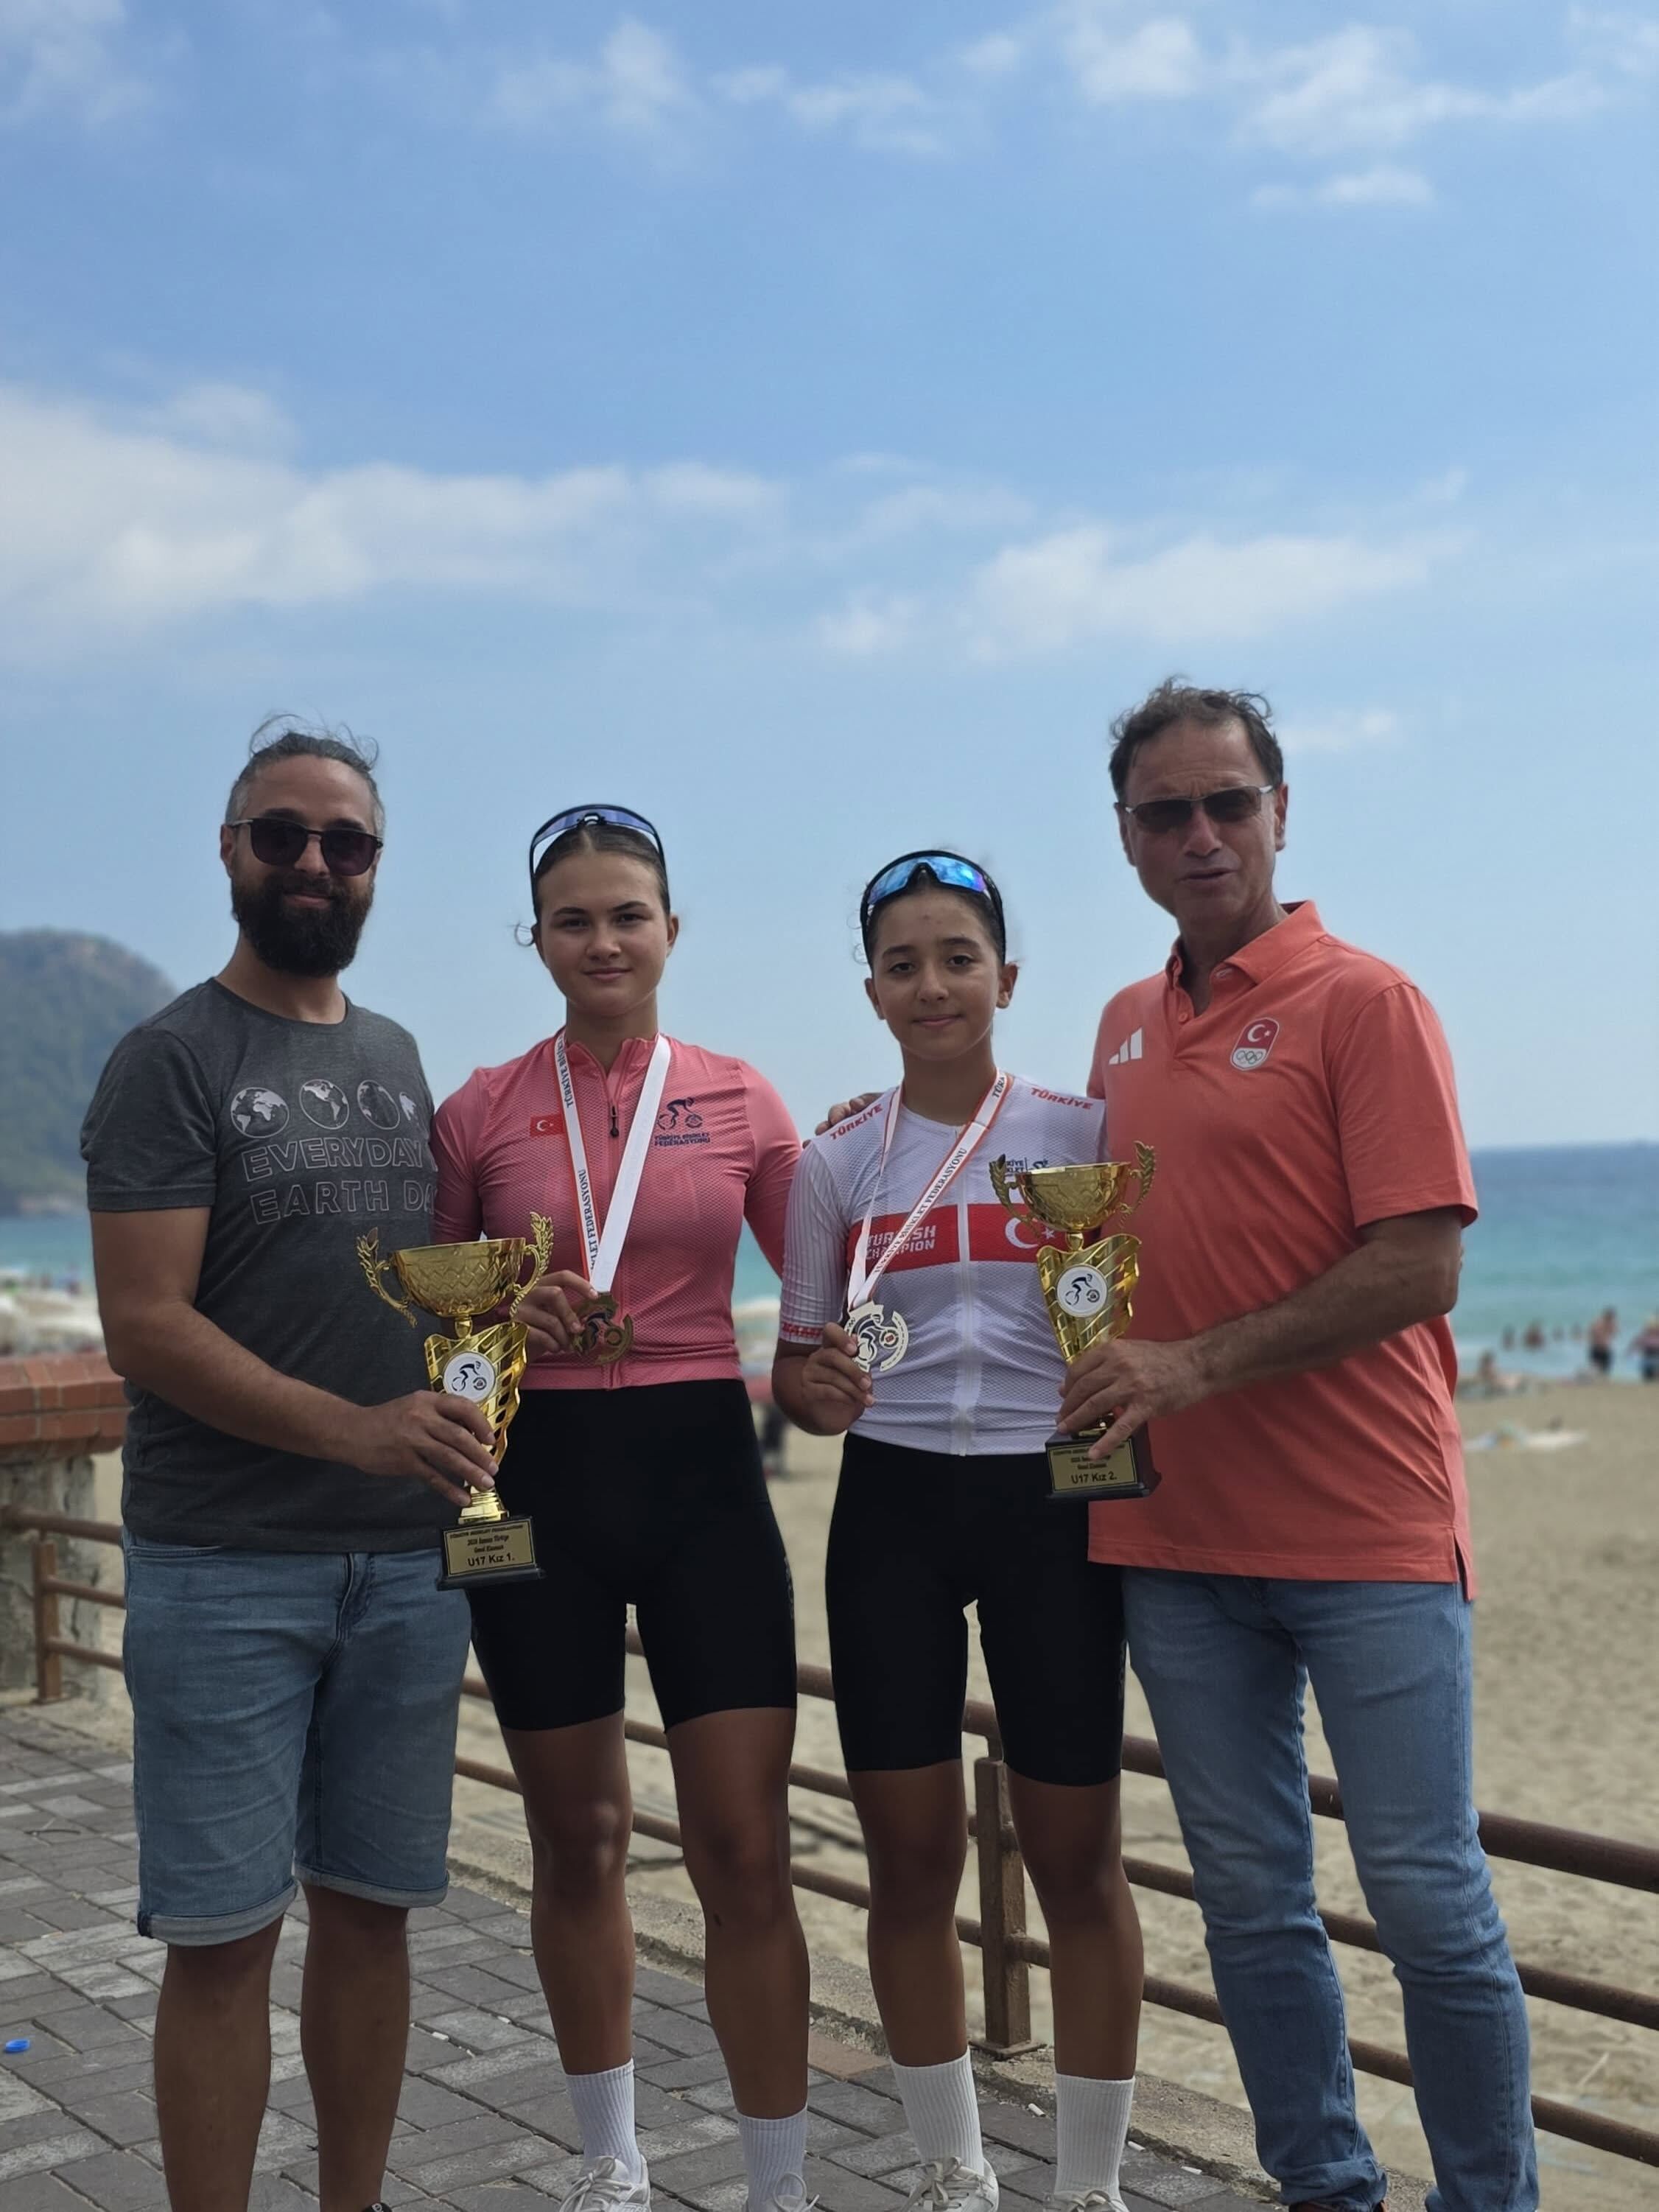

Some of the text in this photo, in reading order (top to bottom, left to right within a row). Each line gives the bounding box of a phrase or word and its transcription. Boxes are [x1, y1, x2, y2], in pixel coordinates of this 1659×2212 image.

[1031, 1087, 1093, 1110] TÜRKİYE
[830, 1104, 883, 1140] TÜRKİYE
[925, 1147, 967, 1204] FEDERASYONU
[250, 1180, 390, 1225] EARTH
[578, 1169, 595, 1239] FEDERASYONU
[1071, 1474, 1089, 1484] U17
[468, 1555, 485, 1567] U17
[506, 1552, 515, 1561] 1.
